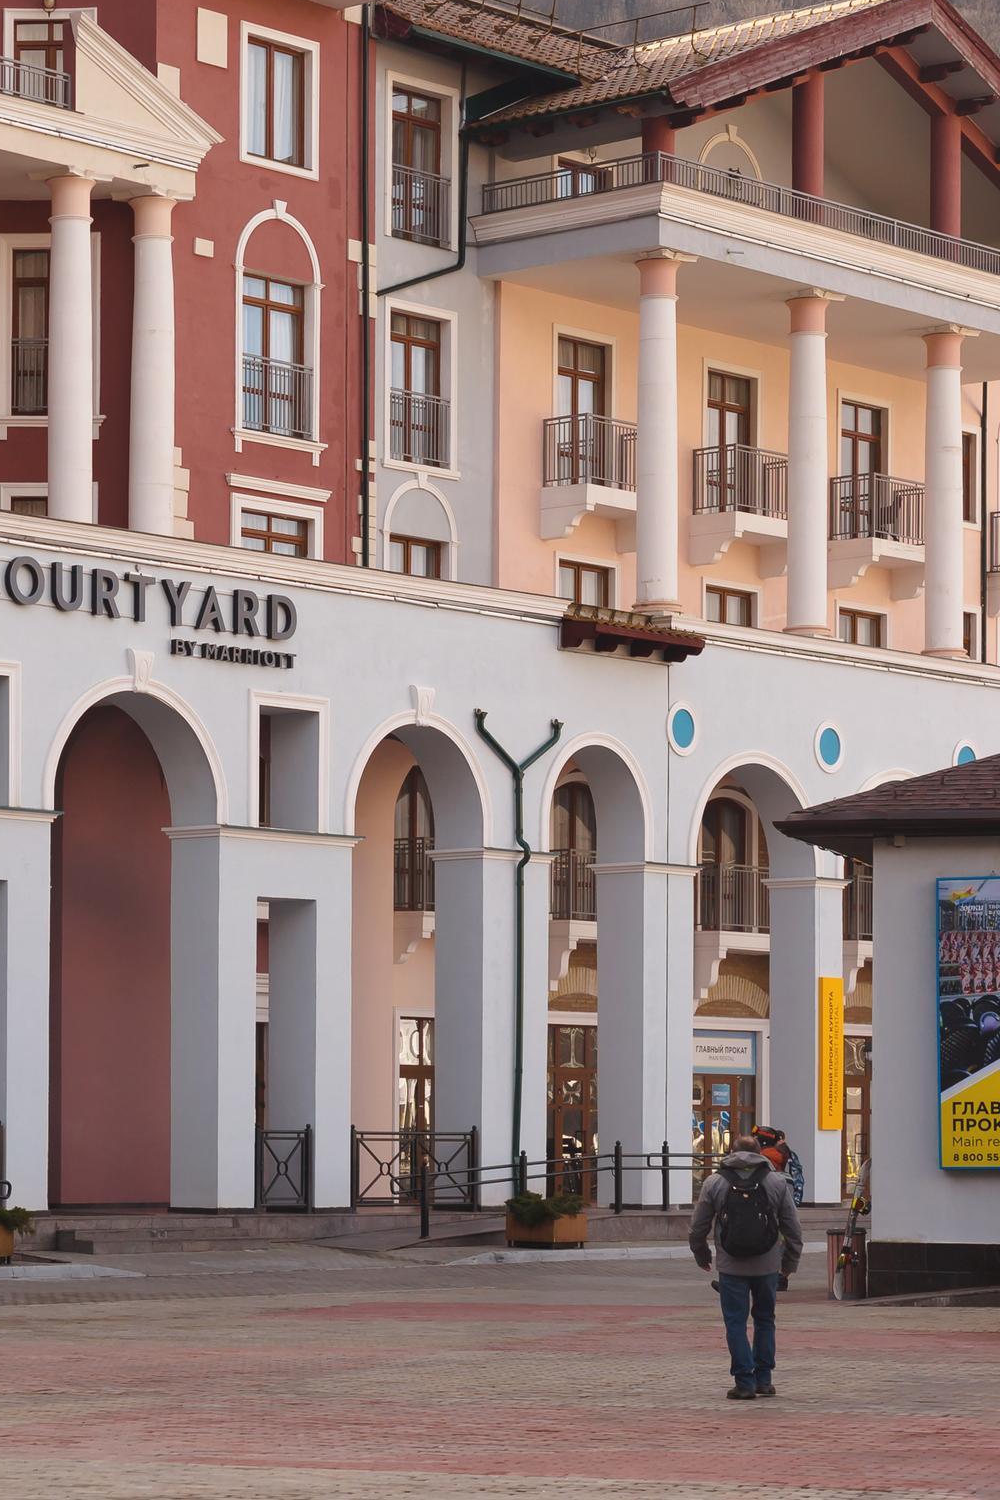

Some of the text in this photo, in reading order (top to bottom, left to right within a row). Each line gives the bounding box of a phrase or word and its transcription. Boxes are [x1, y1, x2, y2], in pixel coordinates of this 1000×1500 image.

[170, 638, 298, 670] BY MARRIOTT
[695, 1045, 748, 1054] ГЛАВНЫЙ ПРОКАТ
[952, 1101, 1000, 1115] ГЛАВ
[952, 1136, 1000, 1147] Main re
[953, 1153, 999, 1162] 8 800 55
